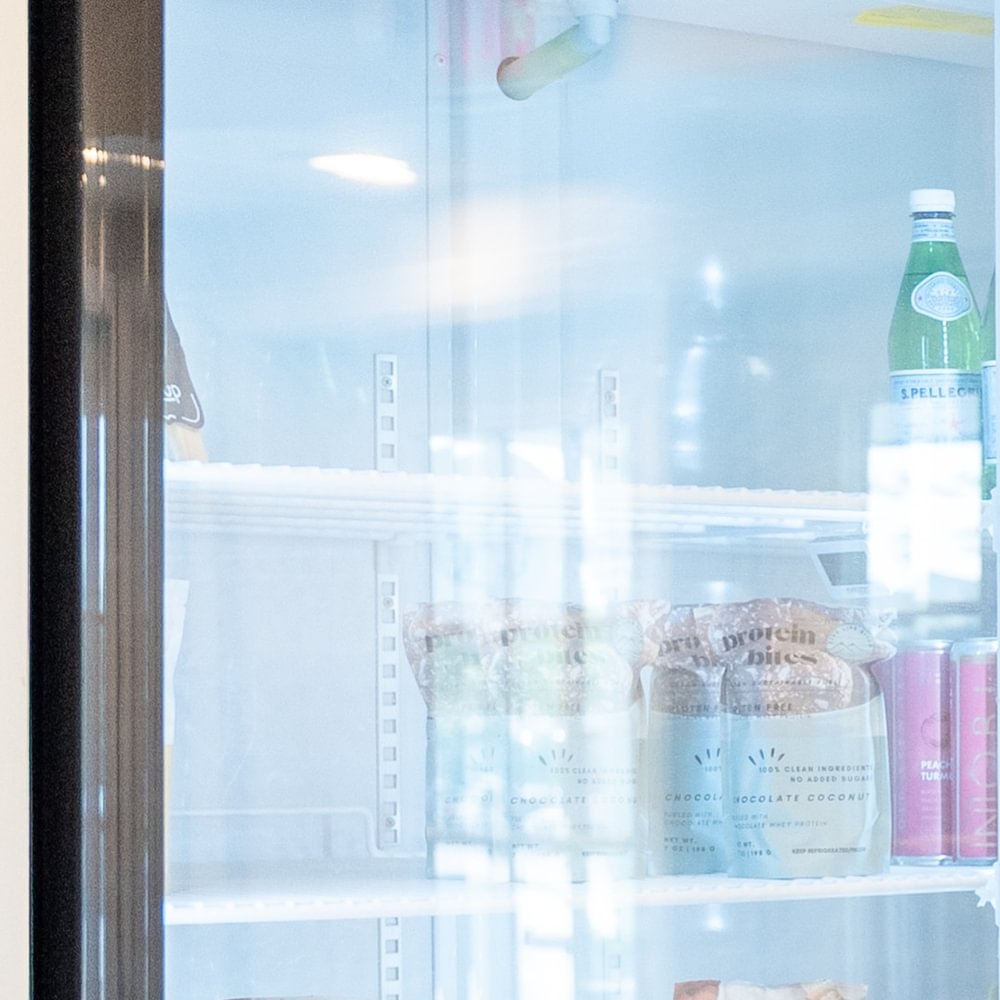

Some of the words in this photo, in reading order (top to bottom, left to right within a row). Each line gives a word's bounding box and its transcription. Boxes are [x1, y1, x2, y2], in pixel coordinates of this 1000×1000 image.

[721, 624, 817, 652] protein
[747, 645, 818, 665] bites
[759, 766, 781, 774] 100%
[784, 765, 814, 773] CLEAN
[790, 775, 804, 783] NO
[807, 775, 838, 783] ADDED
